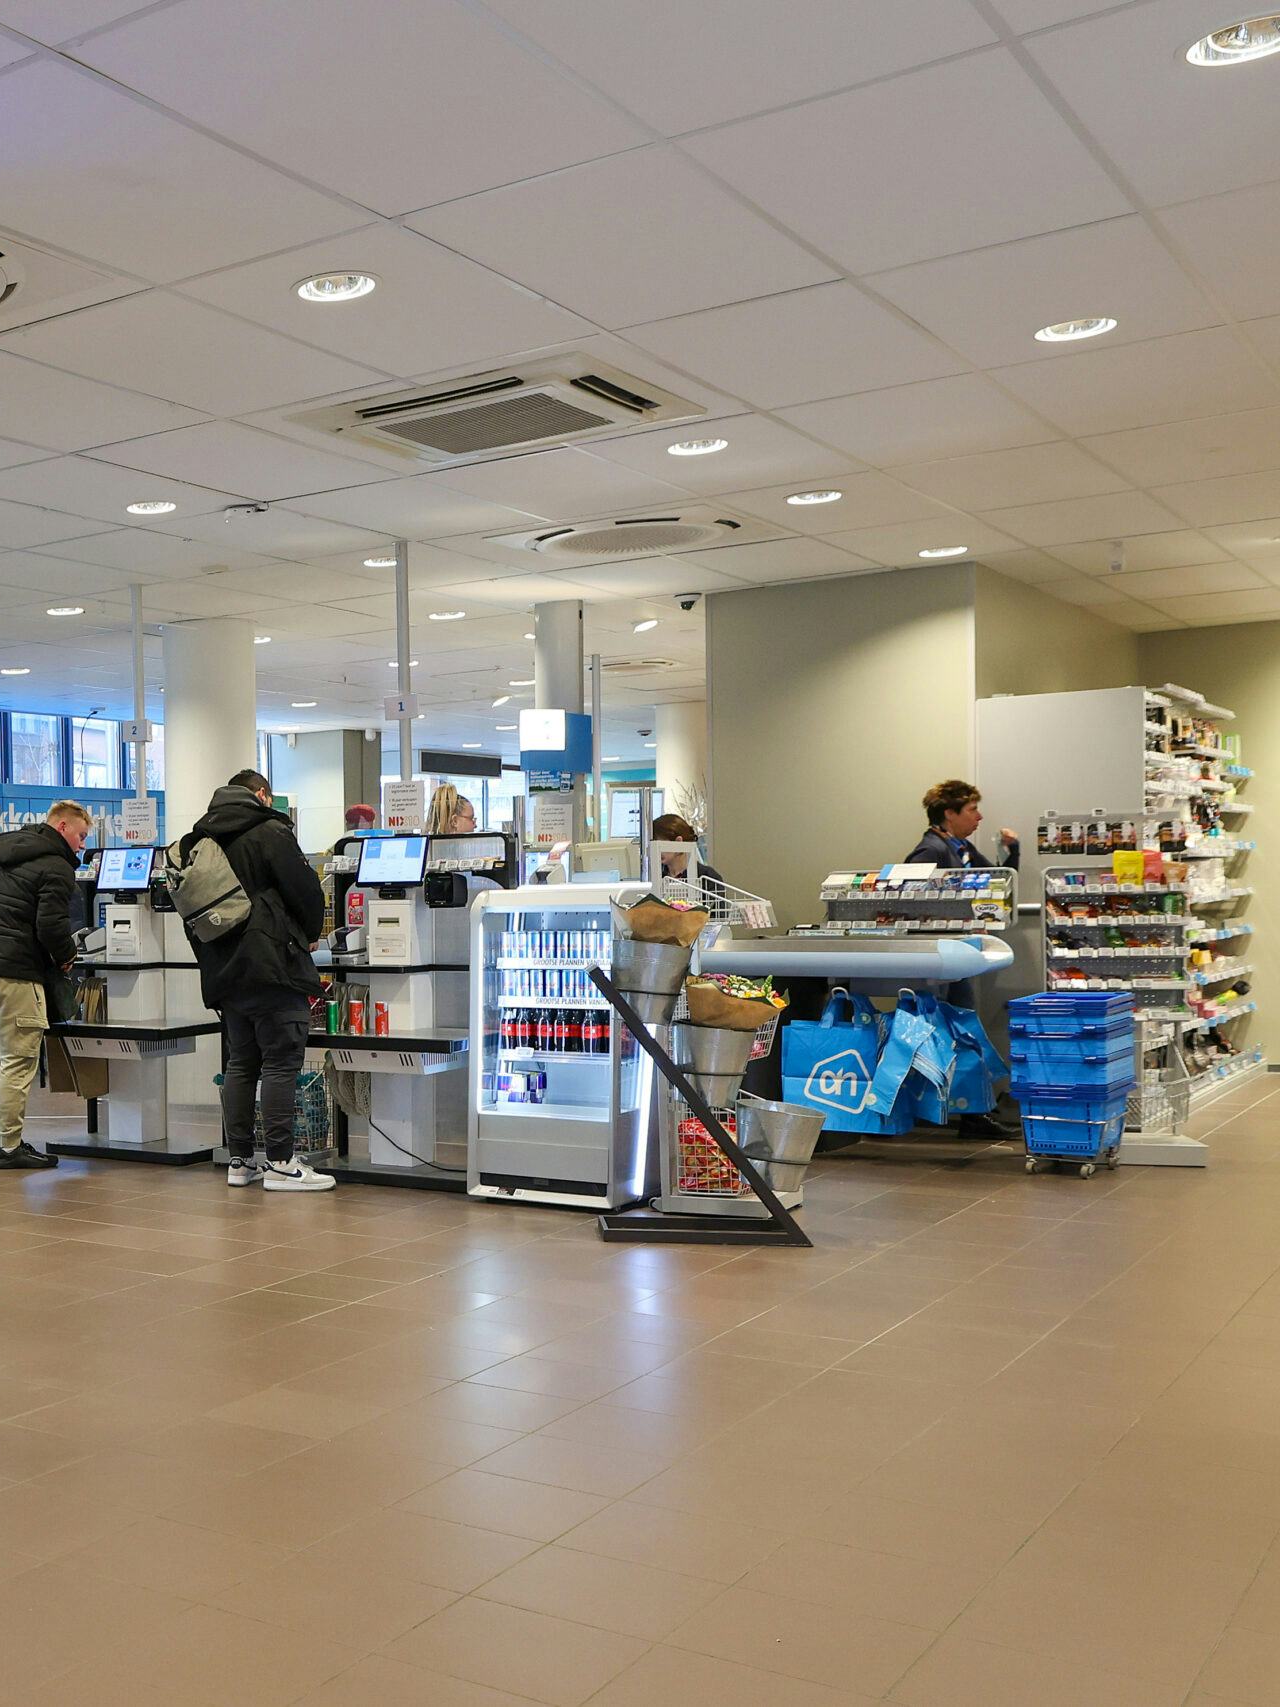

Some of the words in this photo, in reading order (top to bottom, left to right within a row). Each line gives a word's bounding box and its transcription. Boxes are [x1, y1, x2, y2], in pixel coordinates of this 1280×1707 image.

[398, 702, 405, 713] 1
[132, 725, 138, 735] 2
[561, 998, 586, 1006] PLANNEN
